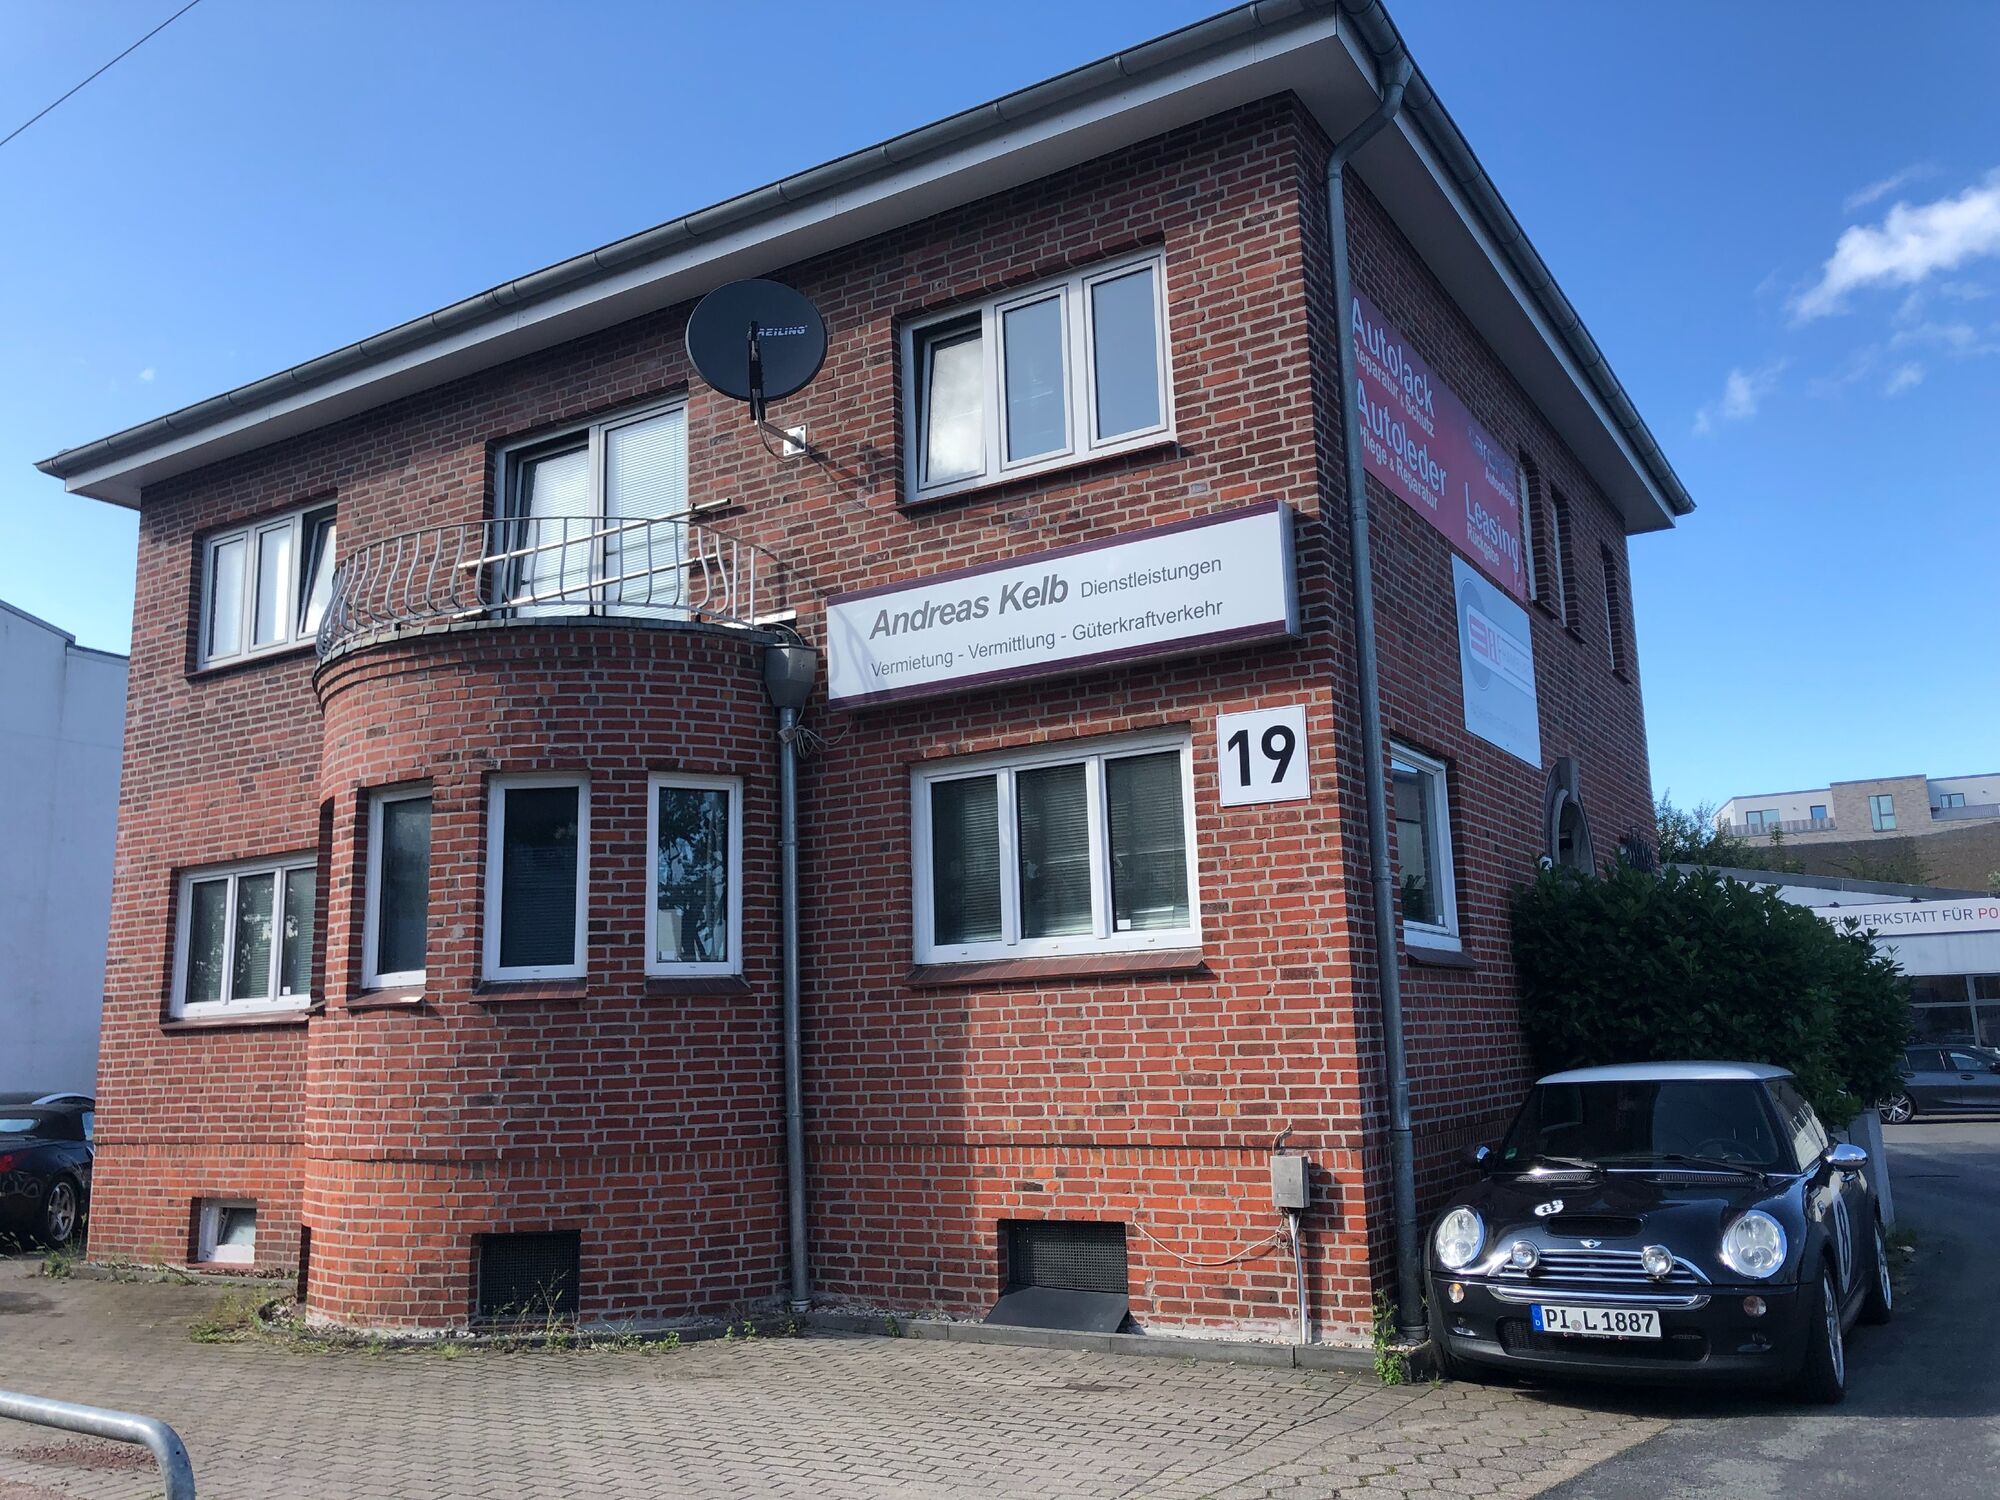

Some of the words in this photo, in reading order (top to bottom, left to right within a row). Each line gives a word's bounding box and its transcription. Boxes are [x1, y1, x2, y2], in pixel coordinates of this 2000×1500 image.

[1352, 297, 1435, 418] Autolack
[1354, 339, 1399, 400] Reparatur
[1405, 394, 1435, 438] Schutz
[1357, 379, 1447, 496] Autoleder
[1396, 456, 1438, 511] Reparatur
[1465, 481, 1520, 574] Leasing
[1466, 521, 1500, 566] Rückgabe
[869, 596, 990, 640] Andreas
[999, 574, 1069, 615] Kelb
[1081, 559, 1222, 598] Dienstleistungen
[871, 651, 953, 677] Vermietung
[968, 632, 1055, 660] Vermittlung
[1072, 600, 1223, 641] Güterkraftverkehr
[1227, 725, 1296, 787] 19
[1942, 907, 1974, 921] FÜR
[1544, 1308, 1571, 1329] PI
